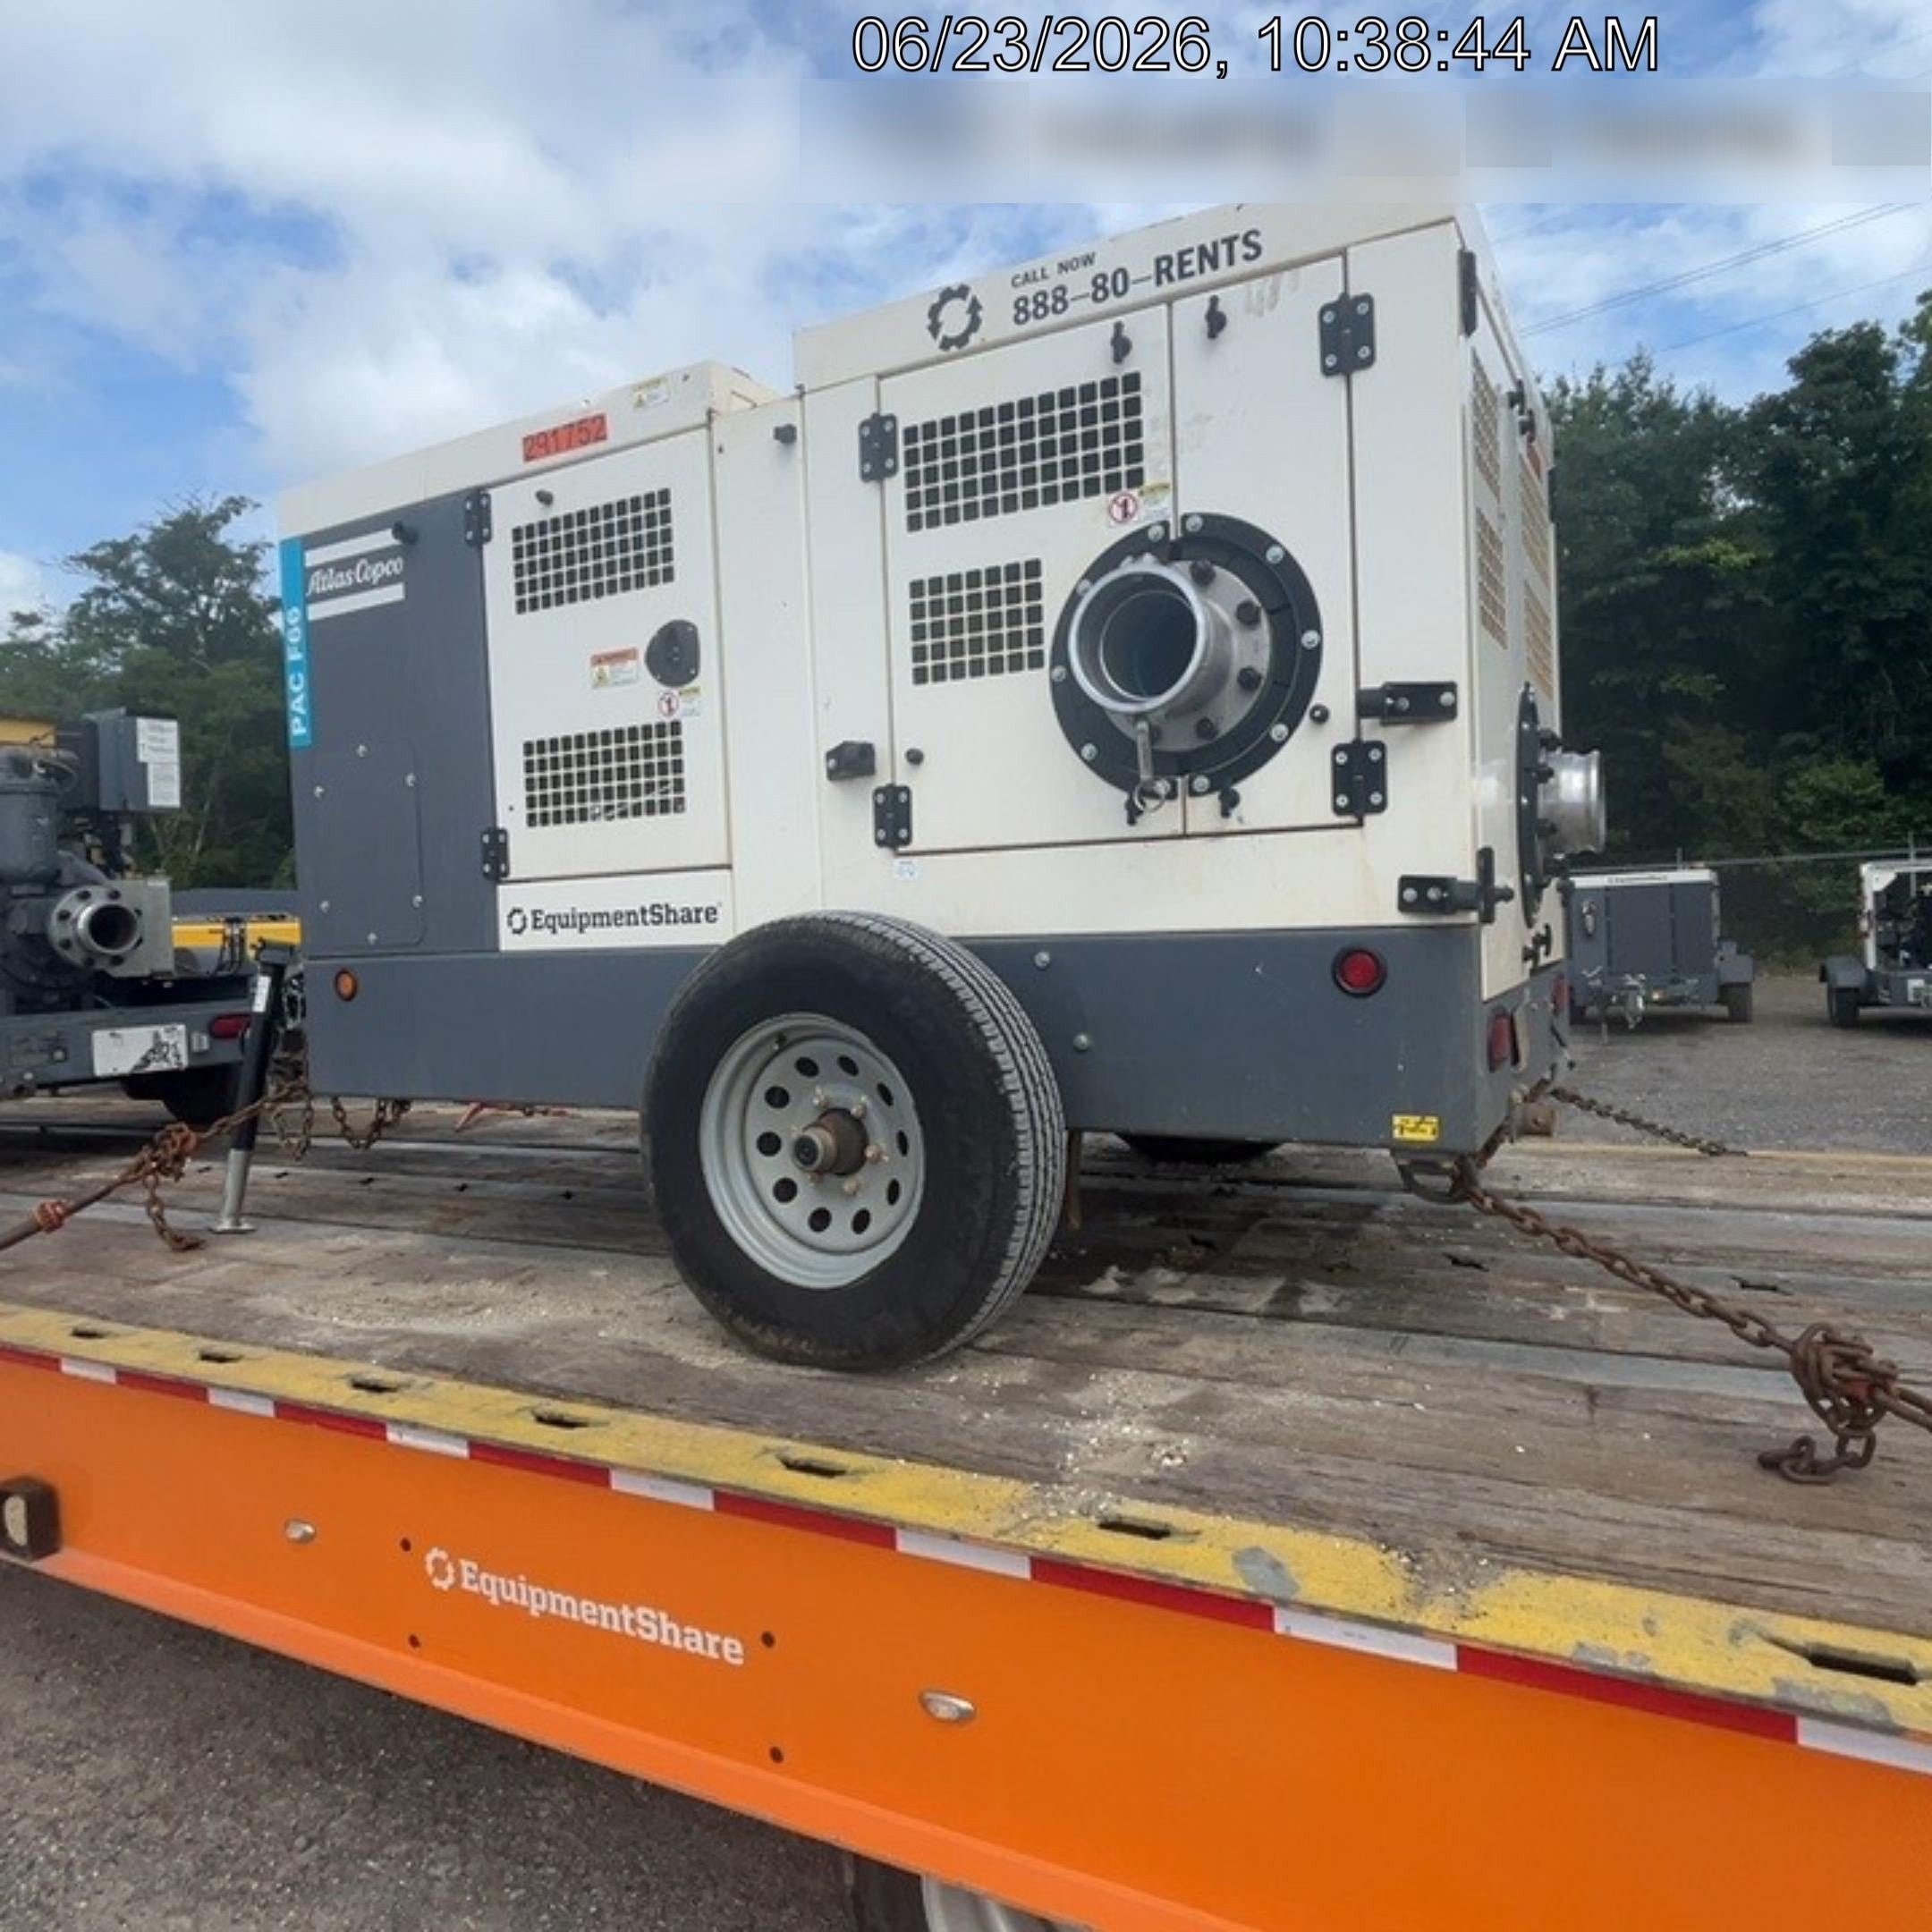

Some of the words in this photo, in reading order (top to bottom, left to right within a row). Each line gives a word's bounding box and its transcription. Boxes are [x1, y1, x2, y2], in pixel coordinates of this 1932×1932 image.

[1011, 267, 1049, 288] CALL
[1057, 252, 1096, 275] NOW
[523, 413, 606, 462] 291752
[289, 672, 307, 735] PAC
[530, 902, 717, 934] EquipmentShare
[459, 1558, 745, 1665] EquipmentShare
